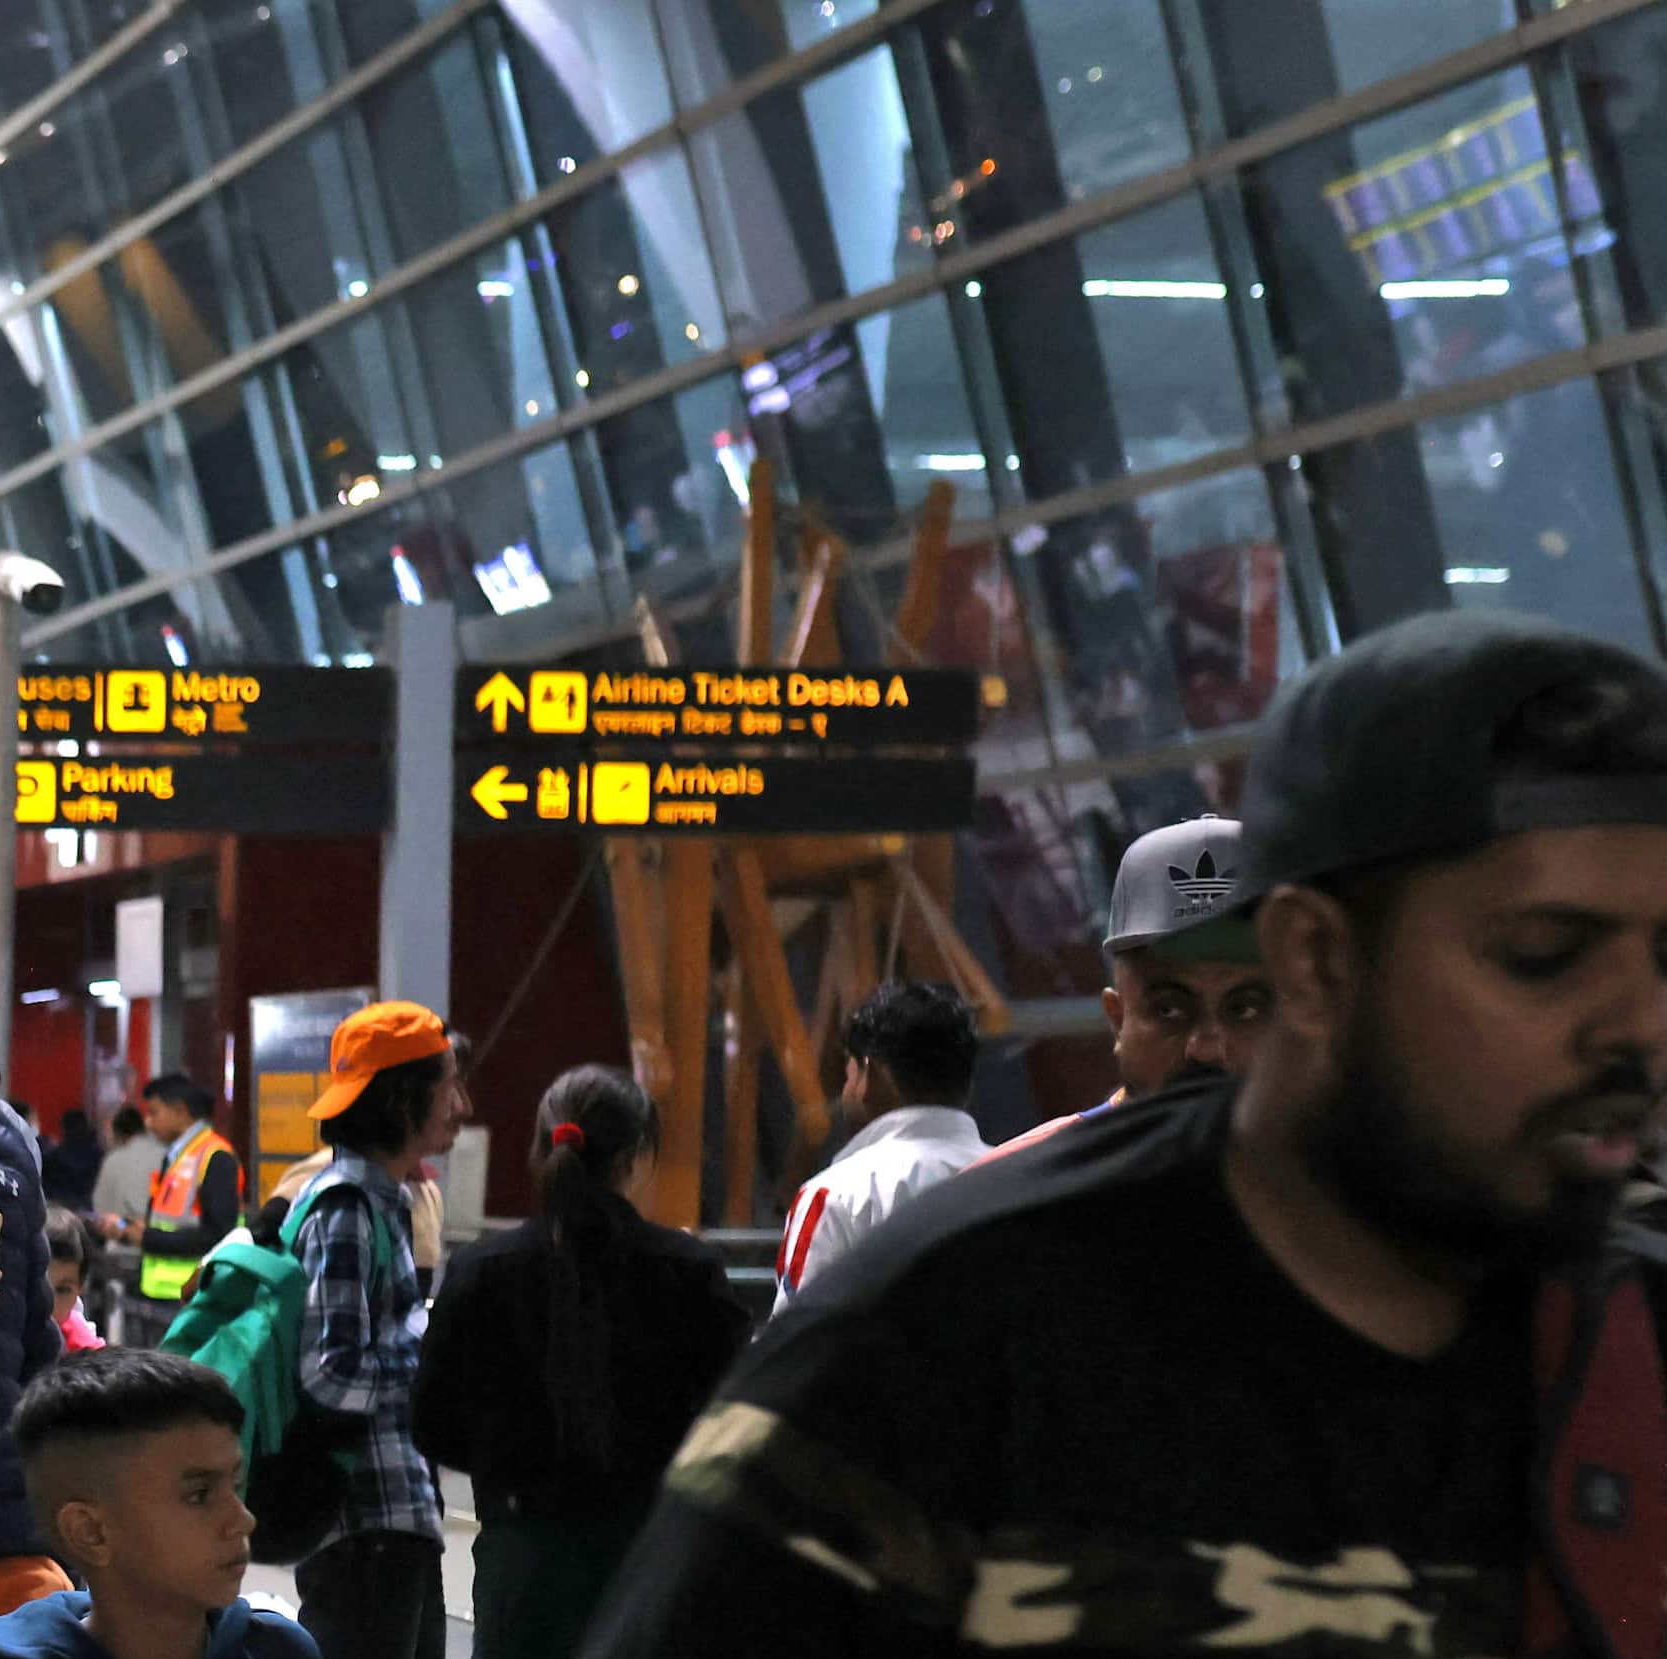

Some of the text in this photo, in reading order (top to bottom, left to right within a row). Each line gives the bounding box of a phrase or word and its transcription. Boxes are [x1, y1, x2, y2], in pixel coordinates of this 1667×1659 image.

[17, 675, 91, 702] uses
[171, 671, 261, 703] Metro
[592, 671, 910, 708] Airline Ticket Desks A
[61, 761, 175, 800] Parking
[654, 762, 765, 797] Arrivals
